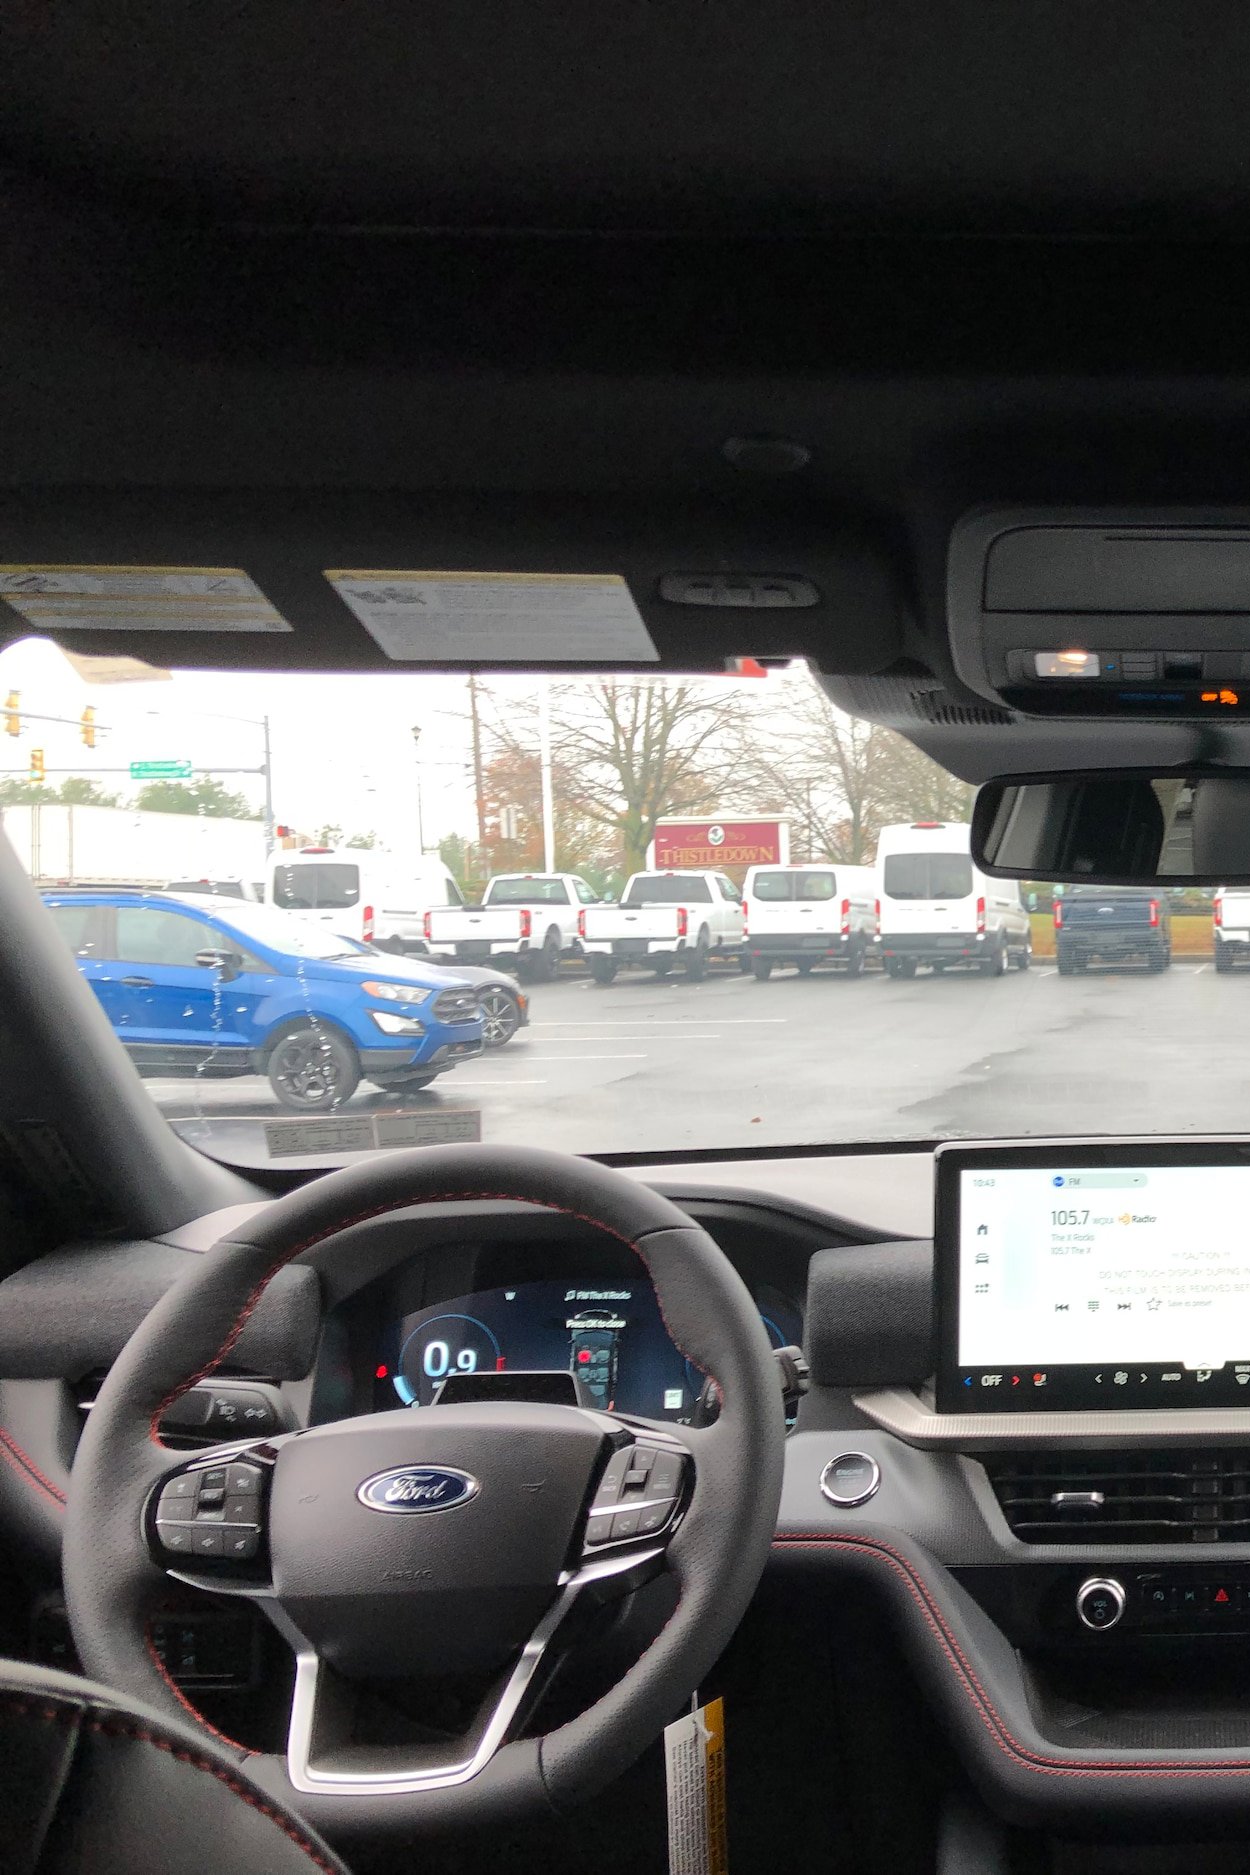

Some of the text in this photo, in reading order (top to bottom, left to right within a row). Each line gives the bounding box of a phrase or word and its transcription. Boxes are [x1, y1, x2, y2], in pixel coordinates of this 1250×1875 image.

[661, 846, 775, 865] THISTLEDOWN
[1051, 1210, 1090, 1226] 105.7
[1131, 1215, 1158, 1223] Radio
[424, 1341, 477, 1377] 0.9
[981, 1375, 1003, 1387] OFF
[1161, 1373, 1182, 1381] AUTO
[385, 1474, 448, 1502] Ford
